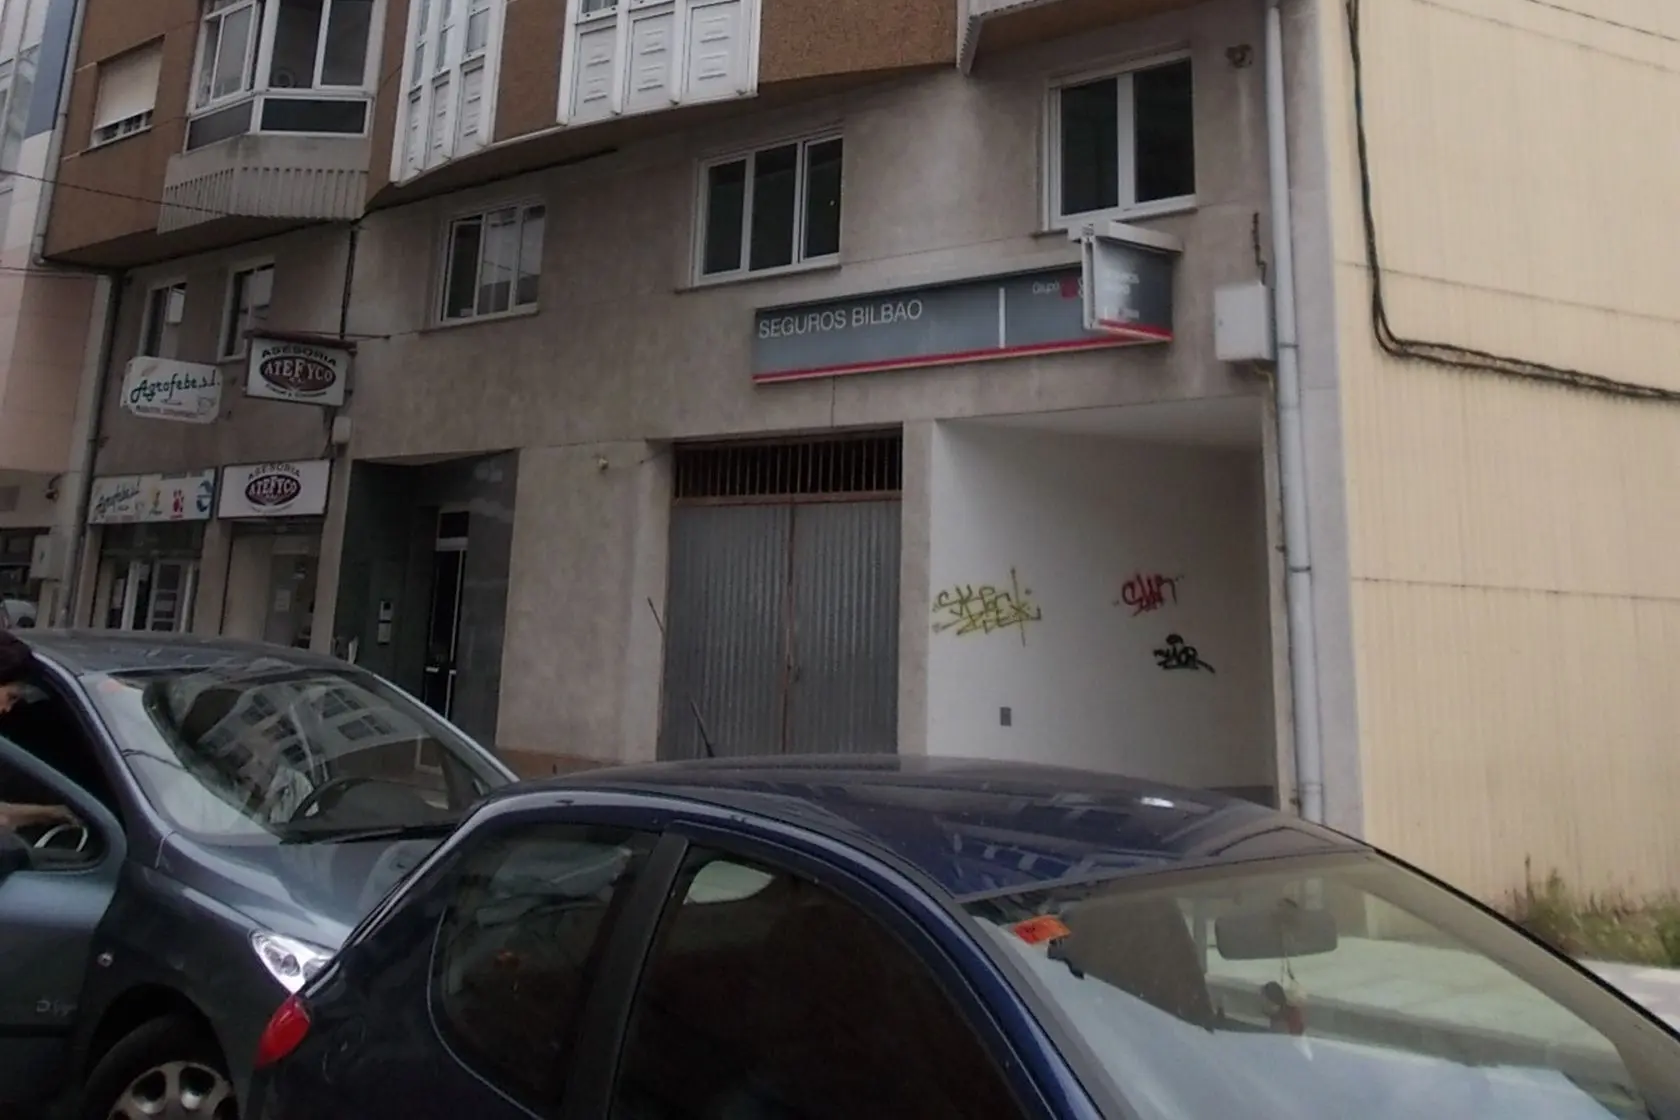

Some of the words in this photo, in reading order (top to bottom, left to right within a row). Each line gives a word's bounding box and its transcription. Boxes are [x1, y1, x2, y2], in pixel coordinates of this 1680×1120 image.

[758, 309, 847, 339] SEGUROS
[851, 300, 923, 329] BILBAO
[264, 359, 334, 382] ATEFYCO
